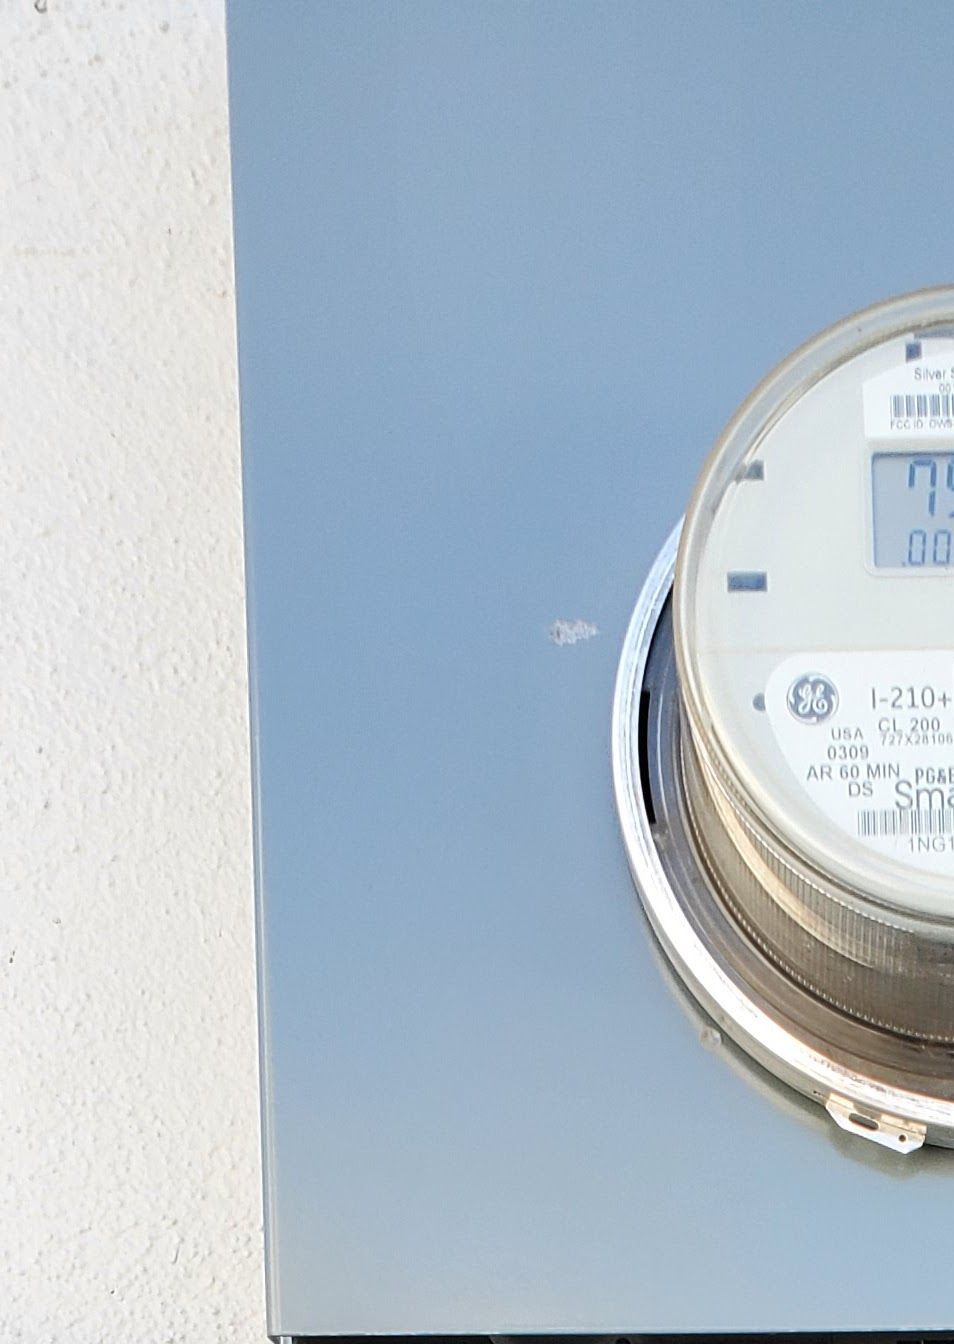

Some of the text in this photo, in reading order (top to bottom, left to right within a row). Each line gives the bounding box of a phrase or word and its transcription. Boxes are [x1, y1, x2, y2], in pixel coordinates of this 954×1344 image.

[914, 368, 946, 381] Silver
[872, 687, 951, 710] I-210+
[879, 718, 898, 732] CL
[910, 718, 940, 732] 200
[832, 728, 863, 740] USA
[827, 745, 869, 760] 0309
[807, 765, 832, 781] AR
[840, 764, 859, 780] 60
[867, 763, 899, 779] MIN
[849, 782, 873, 797] DS
